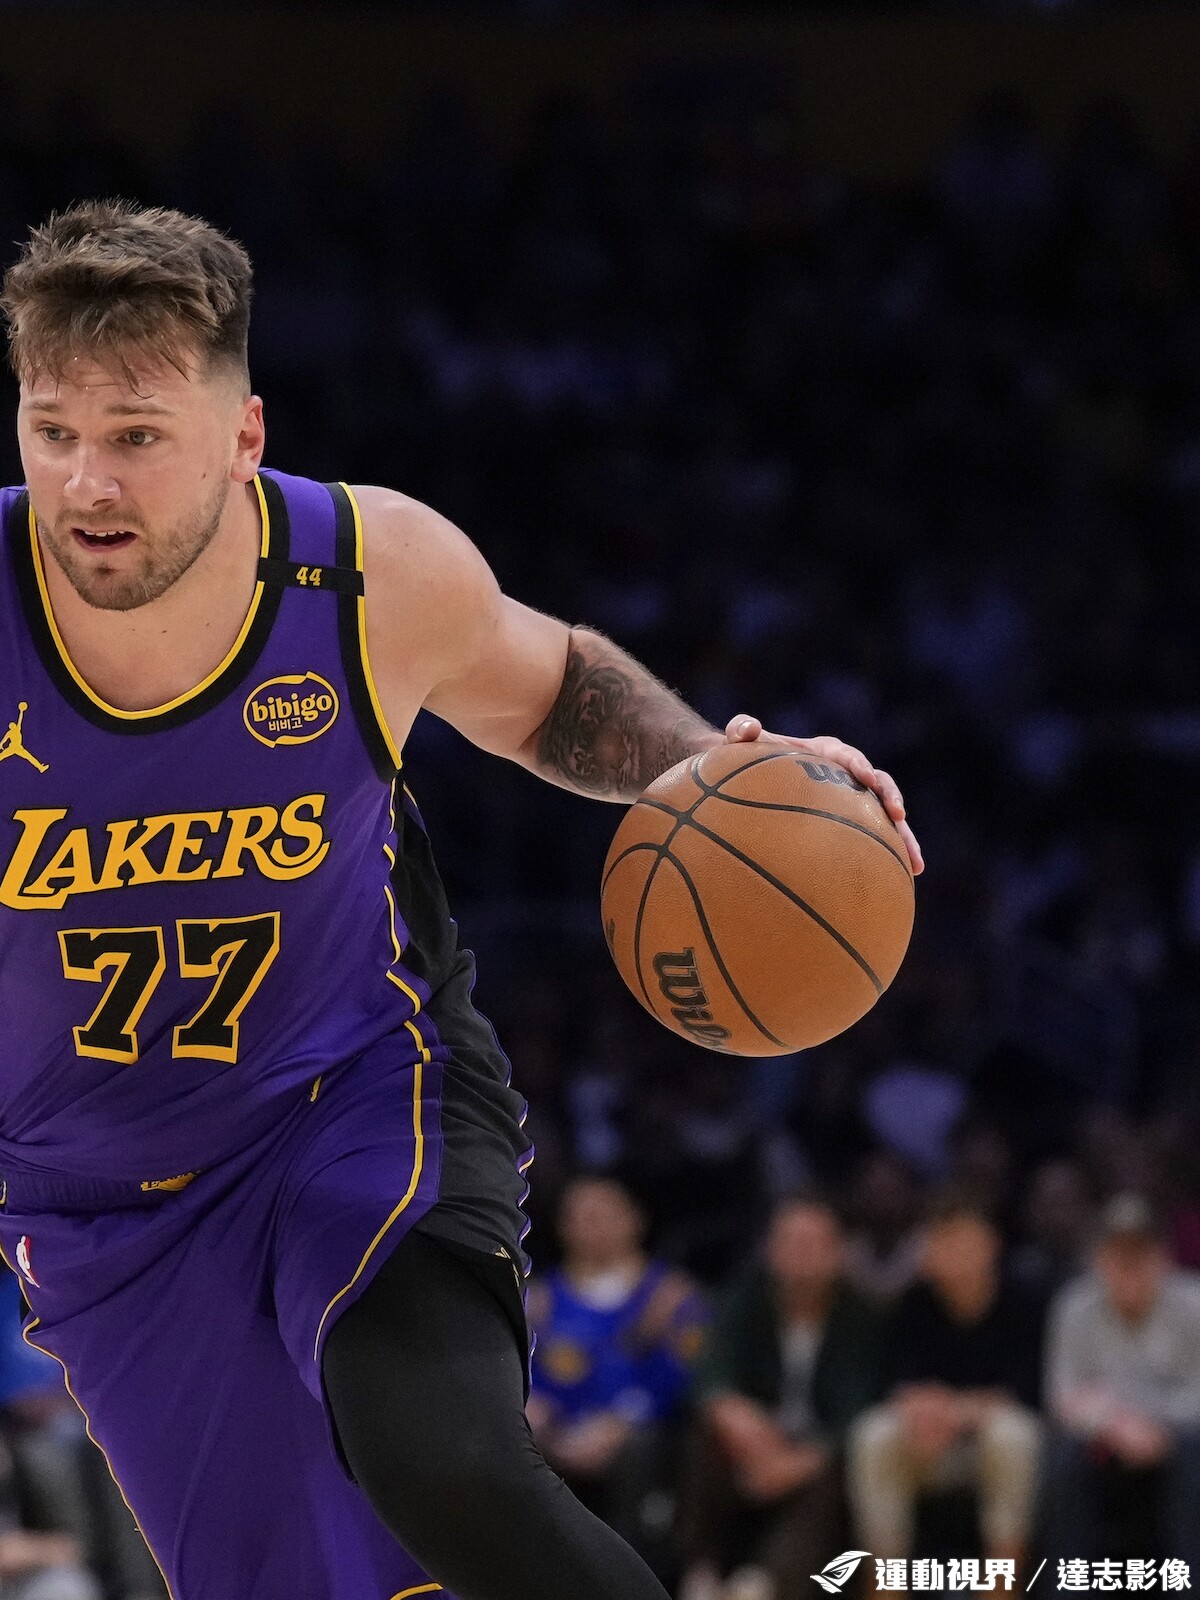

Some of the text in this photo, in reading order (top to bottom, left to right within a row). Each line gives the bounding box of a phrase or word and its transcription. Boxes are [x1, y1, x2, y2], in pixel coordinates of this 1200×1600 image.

[296, 566, 323, 586] 44
[251, 692, 333, 722] bibigo
[268, 716, 303, 732] 비비고
[57, 911, 282, 1065] 77
[652, 946, 732, 1047] Wil
